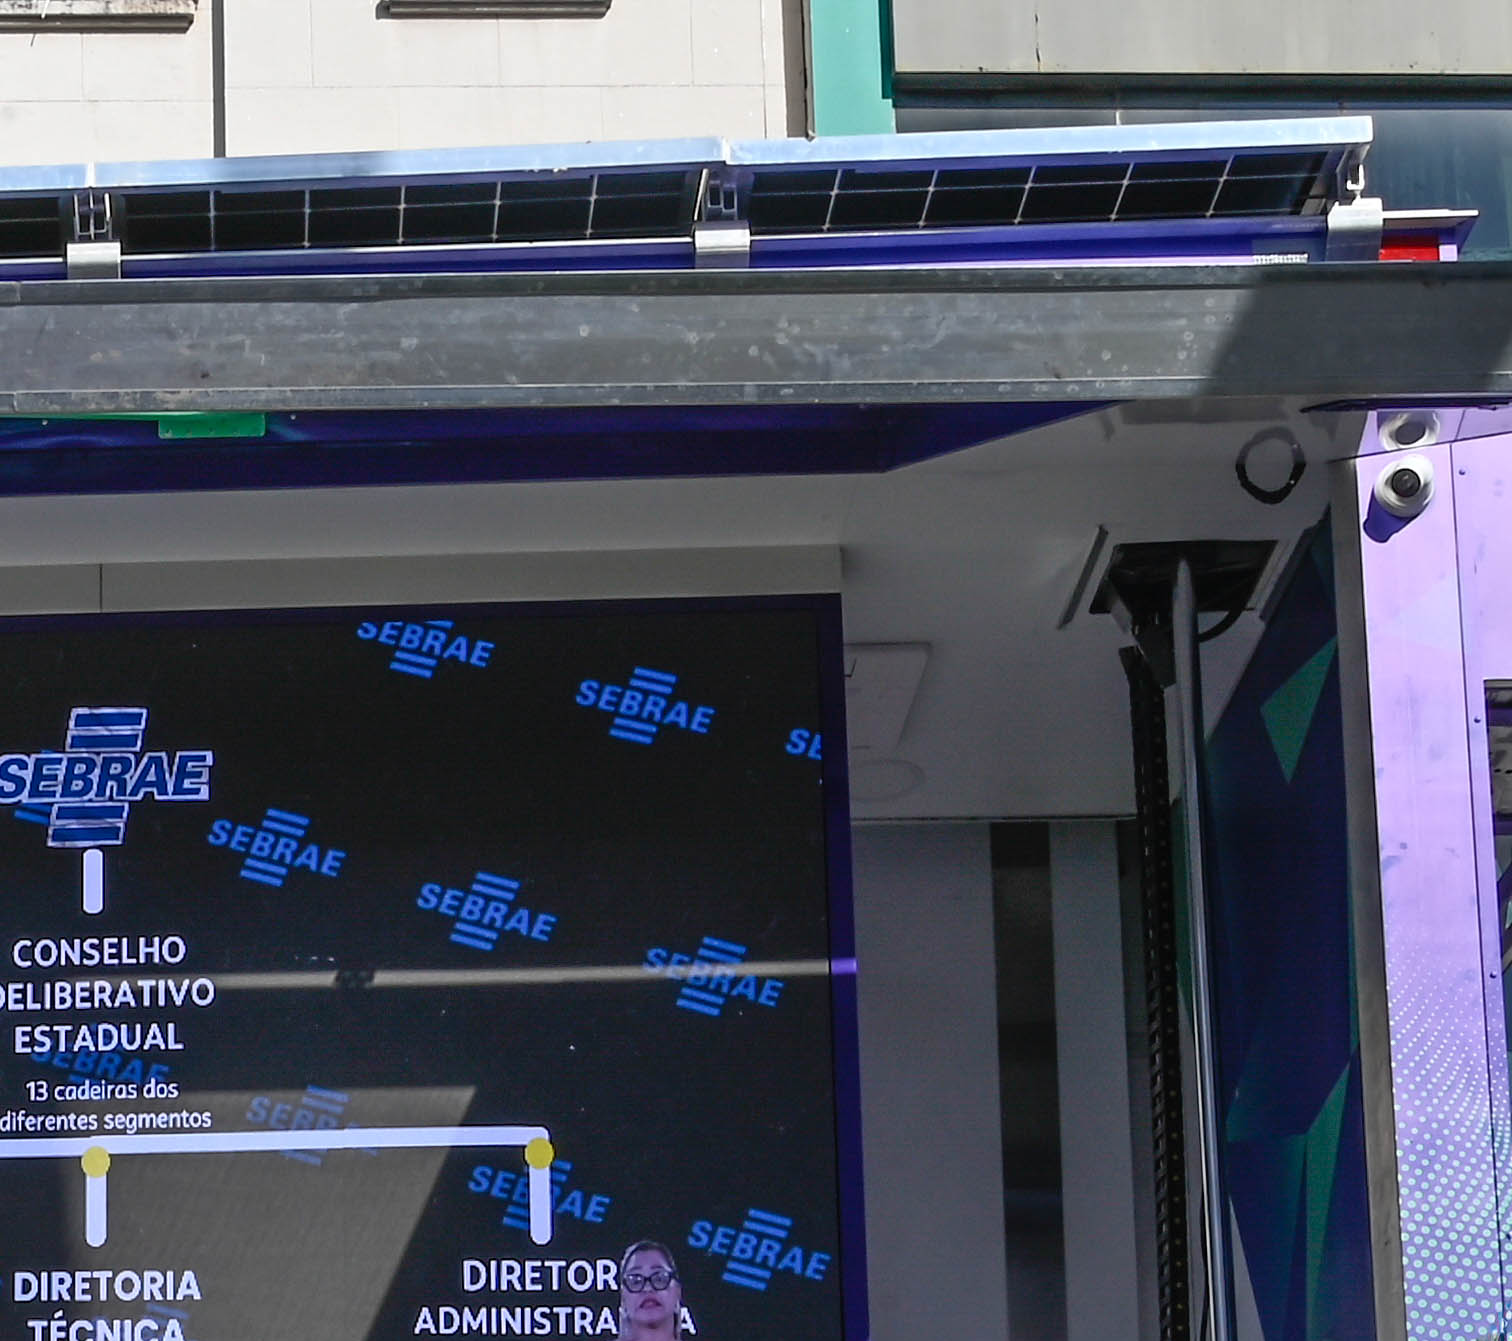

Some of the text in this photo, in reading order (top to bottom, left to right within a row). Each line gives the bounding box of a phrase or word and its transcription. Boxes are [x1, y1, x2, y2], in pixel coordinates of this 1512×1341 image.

[575, 680, 715, 734] SEBRAE
[207, 819, 346, 878] SEBRAE
[415, 882, 557, 942] SEBRAE
[12, 935, 187, 969] CONSELHO
[642, 947, 783, 1007] SEBRAE
[14, 1022, 185, 1055] ESTADUAL
[26, 1077, 179, 1101] 13 cadeiras dos
[0, 1109, 212, 1135] diferentes segmentos
[687, 1221, 832, 1281] SEBRAE
[13, 1270, 202, 1303] DIRETORIA
[462, 1259, 619, 1293] DIRETOR
[413, 1306, 697, 1337] ADMINISTRAA
